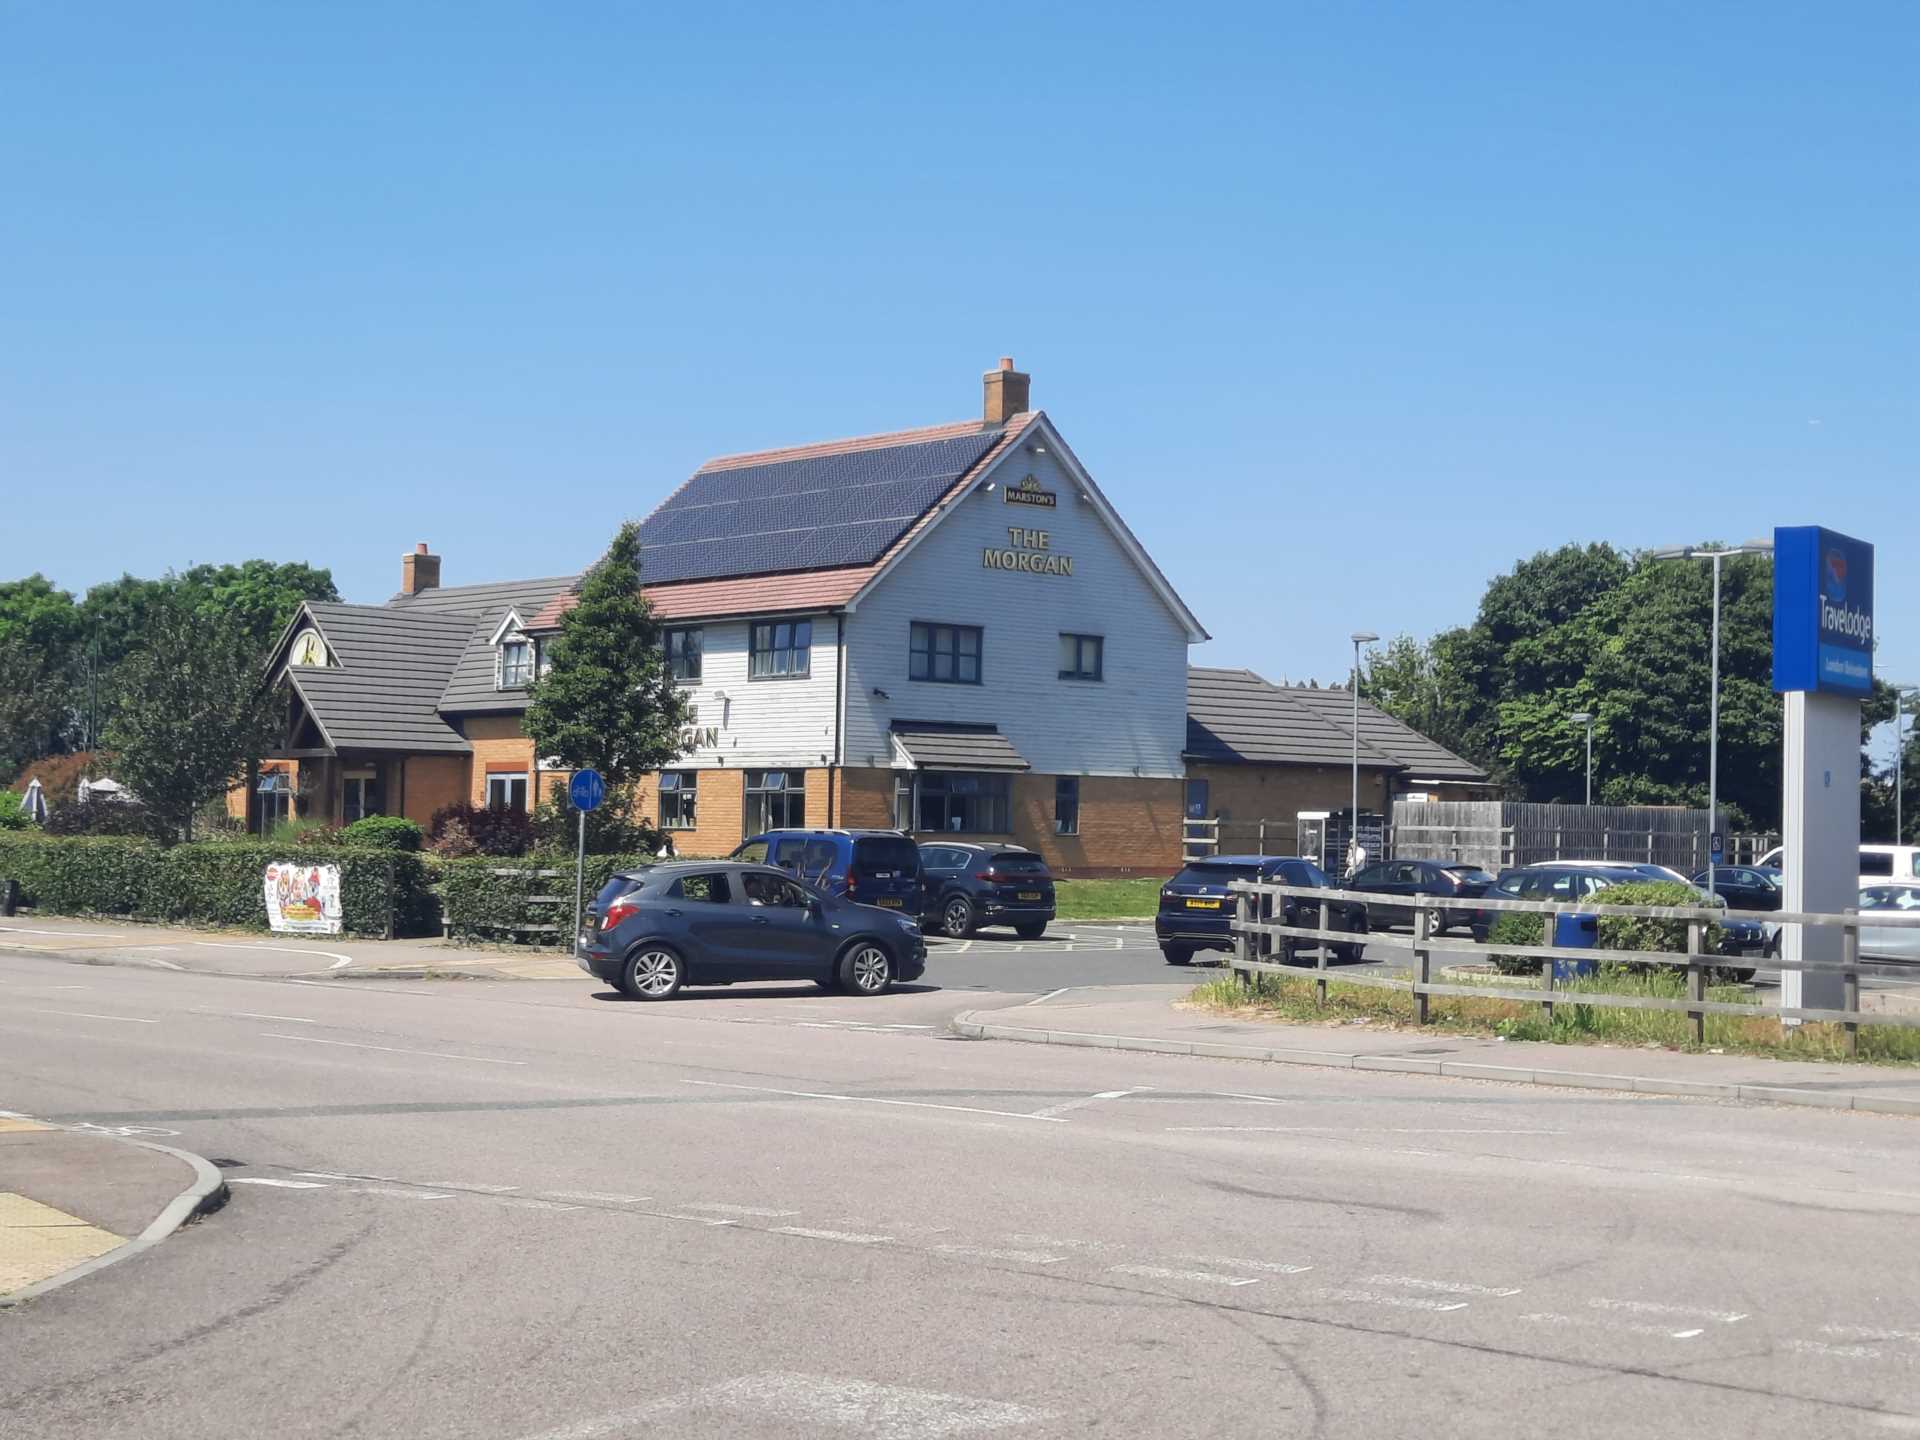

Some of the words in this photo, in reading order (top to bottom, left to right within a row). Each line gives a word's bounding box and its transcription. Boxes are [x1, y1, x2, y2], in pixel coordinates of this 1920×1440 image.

[1007, 490, 1055, 505] MARSTON'S
[1008, 527, 1049, 550] THE
[983, 548, 1073, 576] MORGAN
[1819, 594, 1871, 644] Travelodge
